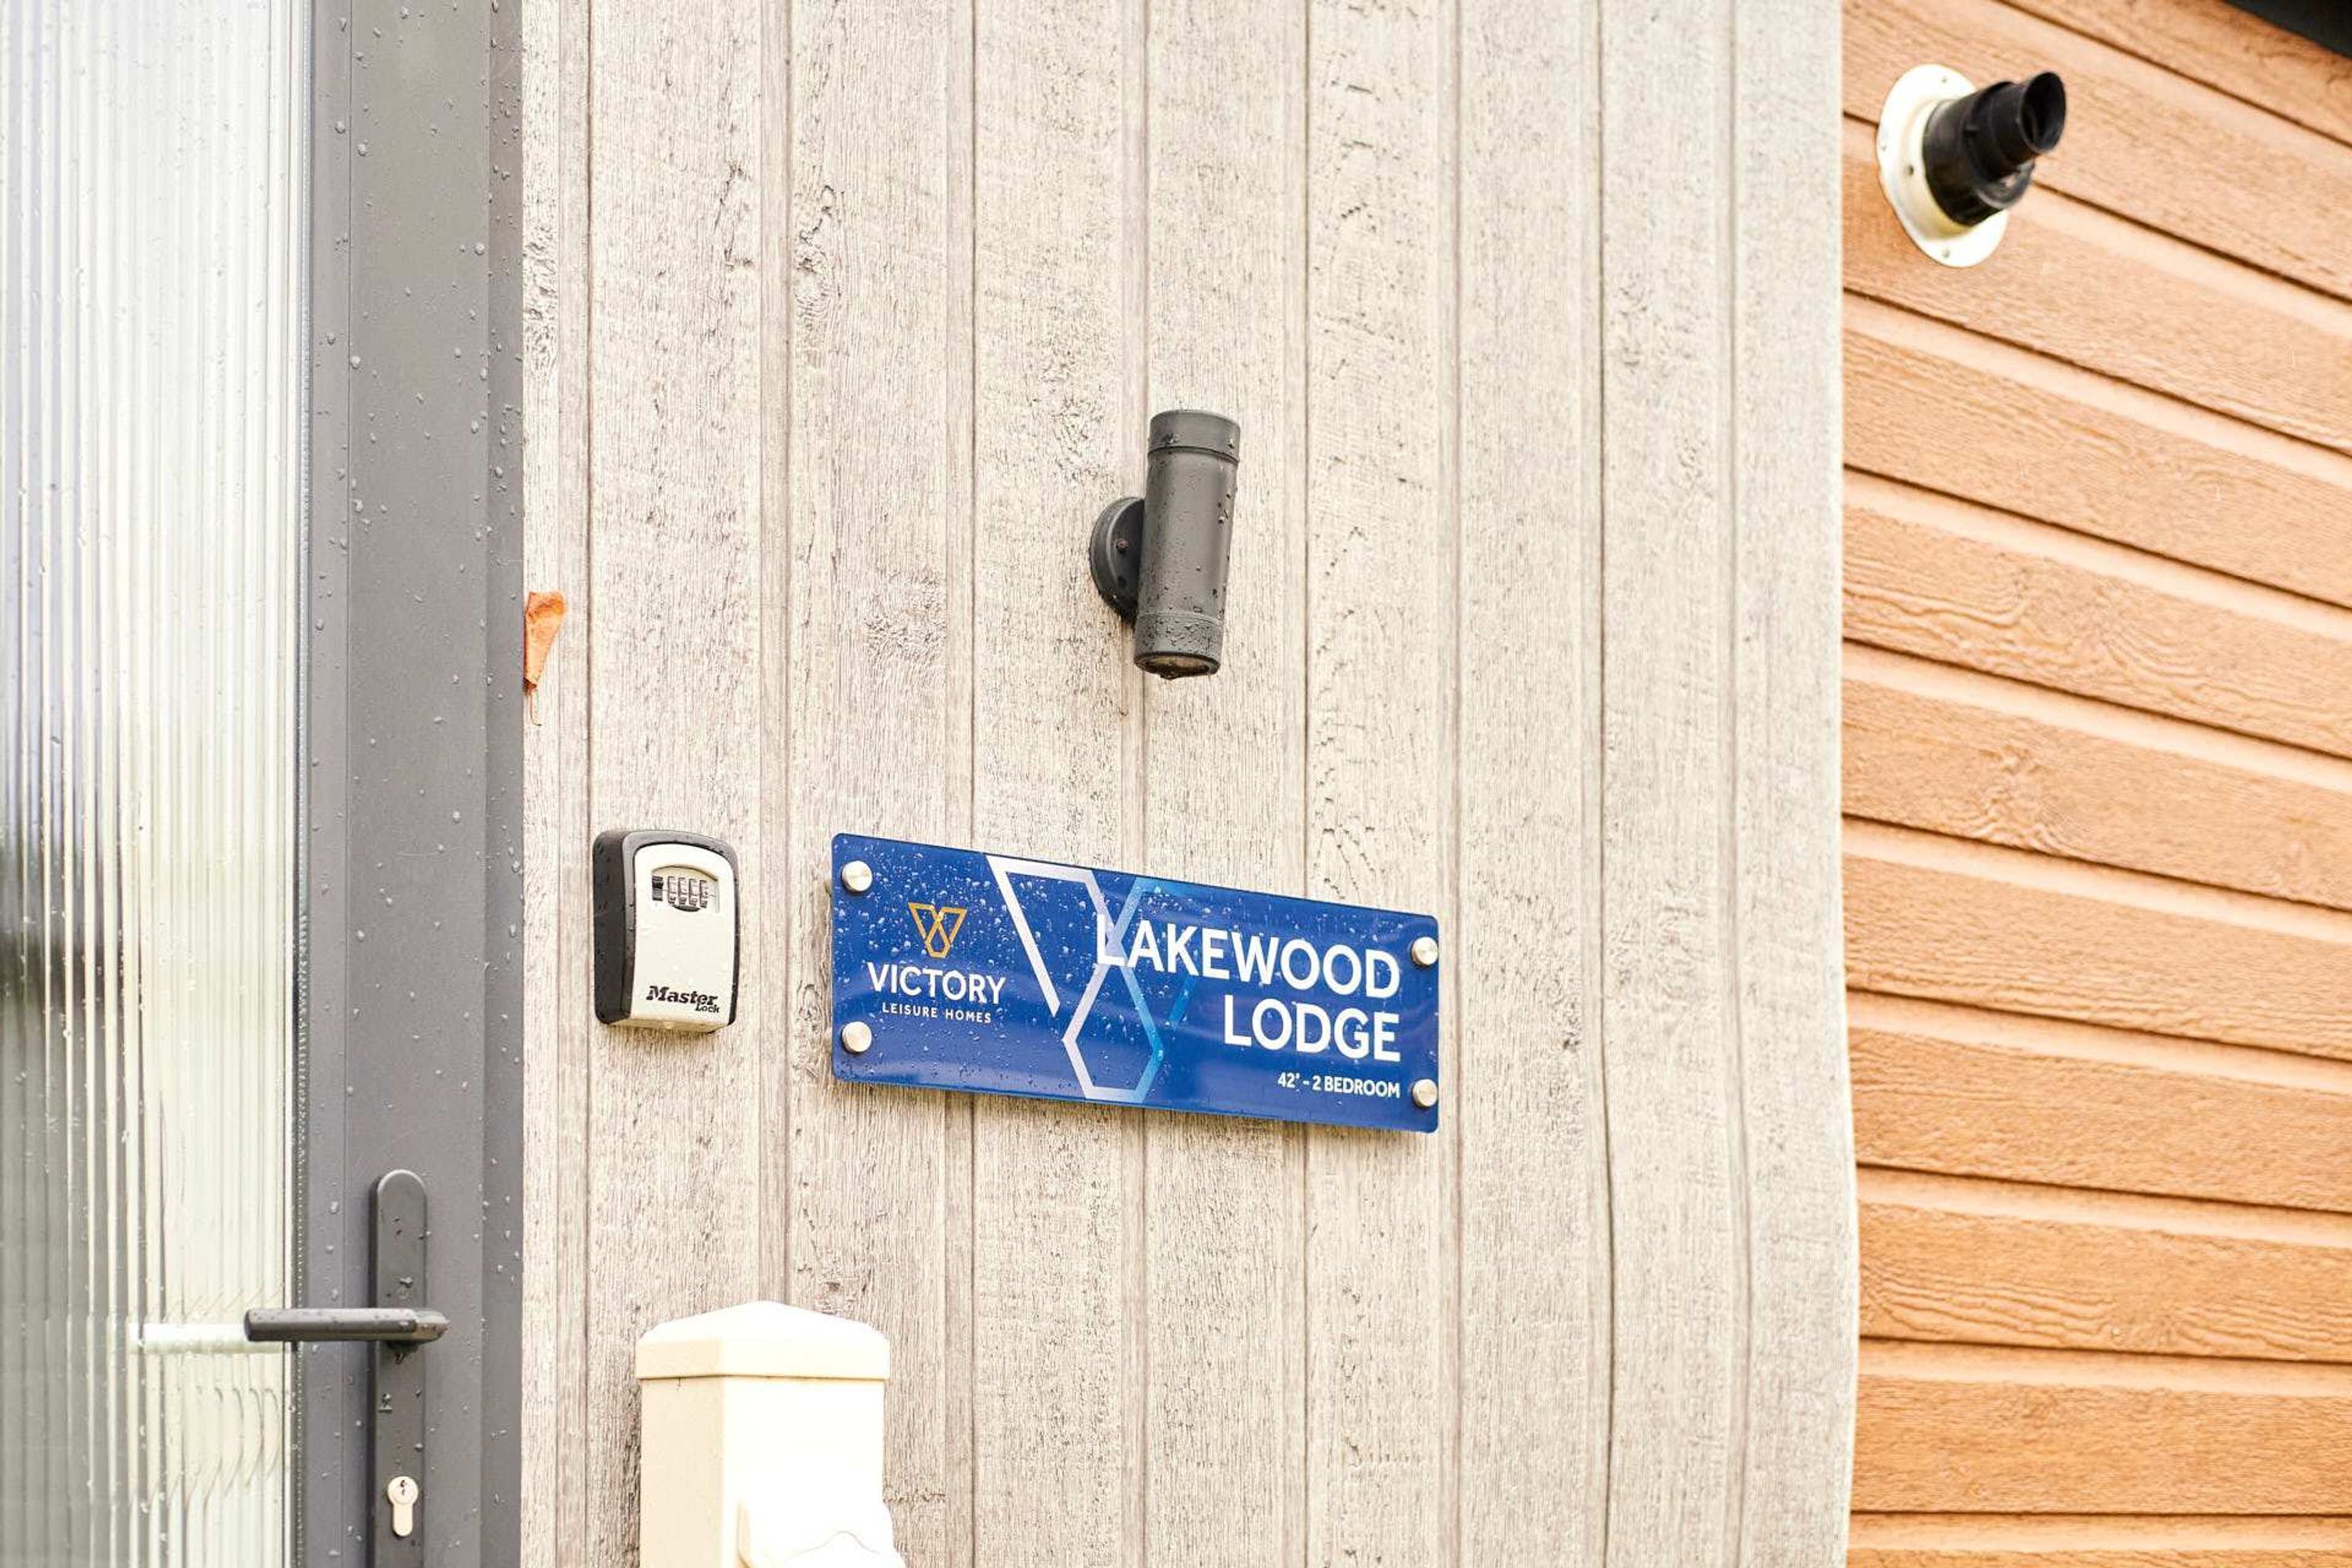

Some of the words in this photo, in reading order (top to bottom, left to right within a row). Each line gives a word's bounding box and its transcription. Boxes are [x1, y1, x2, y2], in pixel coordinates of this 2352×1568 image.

[1097, 914, 1400, 999] LAKEWOOD
[867, 962, 1005, 1004] VICTORY
[646, 985, 717, 1005] Master
[695, 1004, 720, 1013] Lock
[882, 1002, 938, 1018] LEISURE
[945, 1009, 991, 1023] HOMES
[1224, 995, 1401, 1062] LODGE
[1312, 1075, 1321, 1091] 2
[1324, 1076, 1400, 1098] BEDROOM
